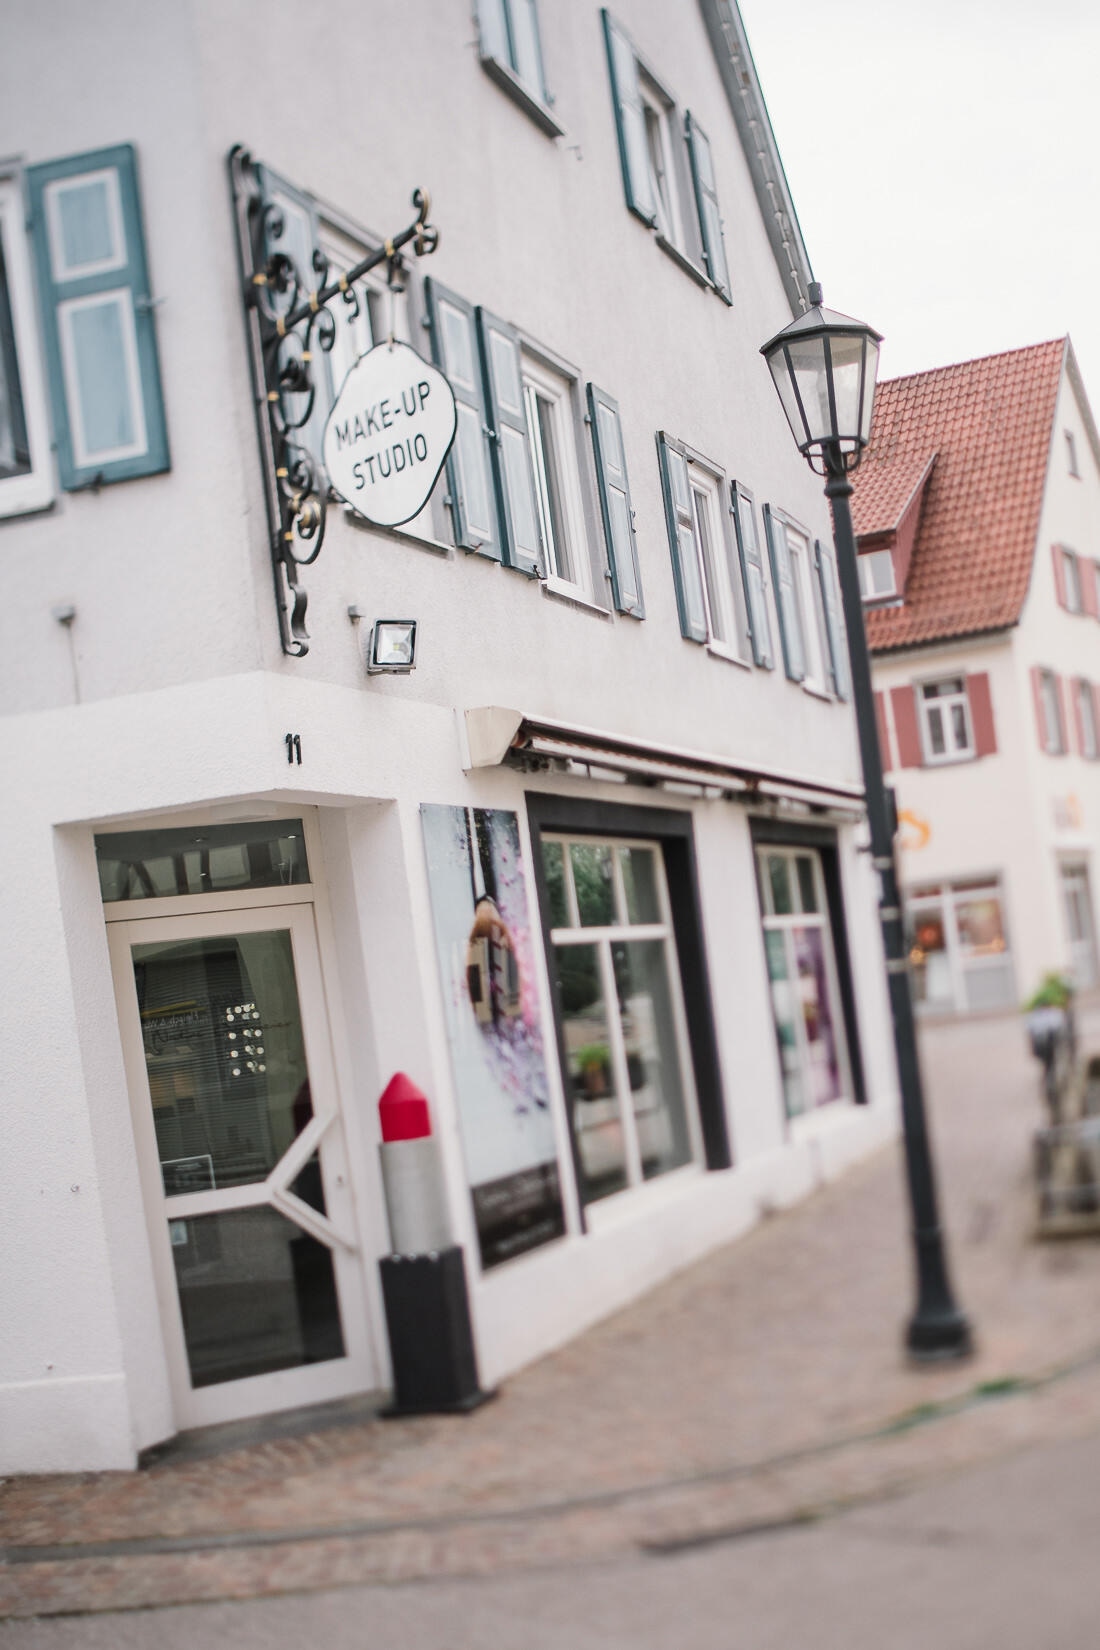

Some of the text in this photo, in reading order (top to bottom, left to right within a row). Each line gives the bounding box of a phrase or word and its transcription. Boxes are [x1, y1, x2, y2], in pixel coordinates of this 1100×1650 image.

[335, 380, 430, 450] MAKE-UP
[352, 433, 428, 490] STUDIO
[285, 733, 303, 766] 11
